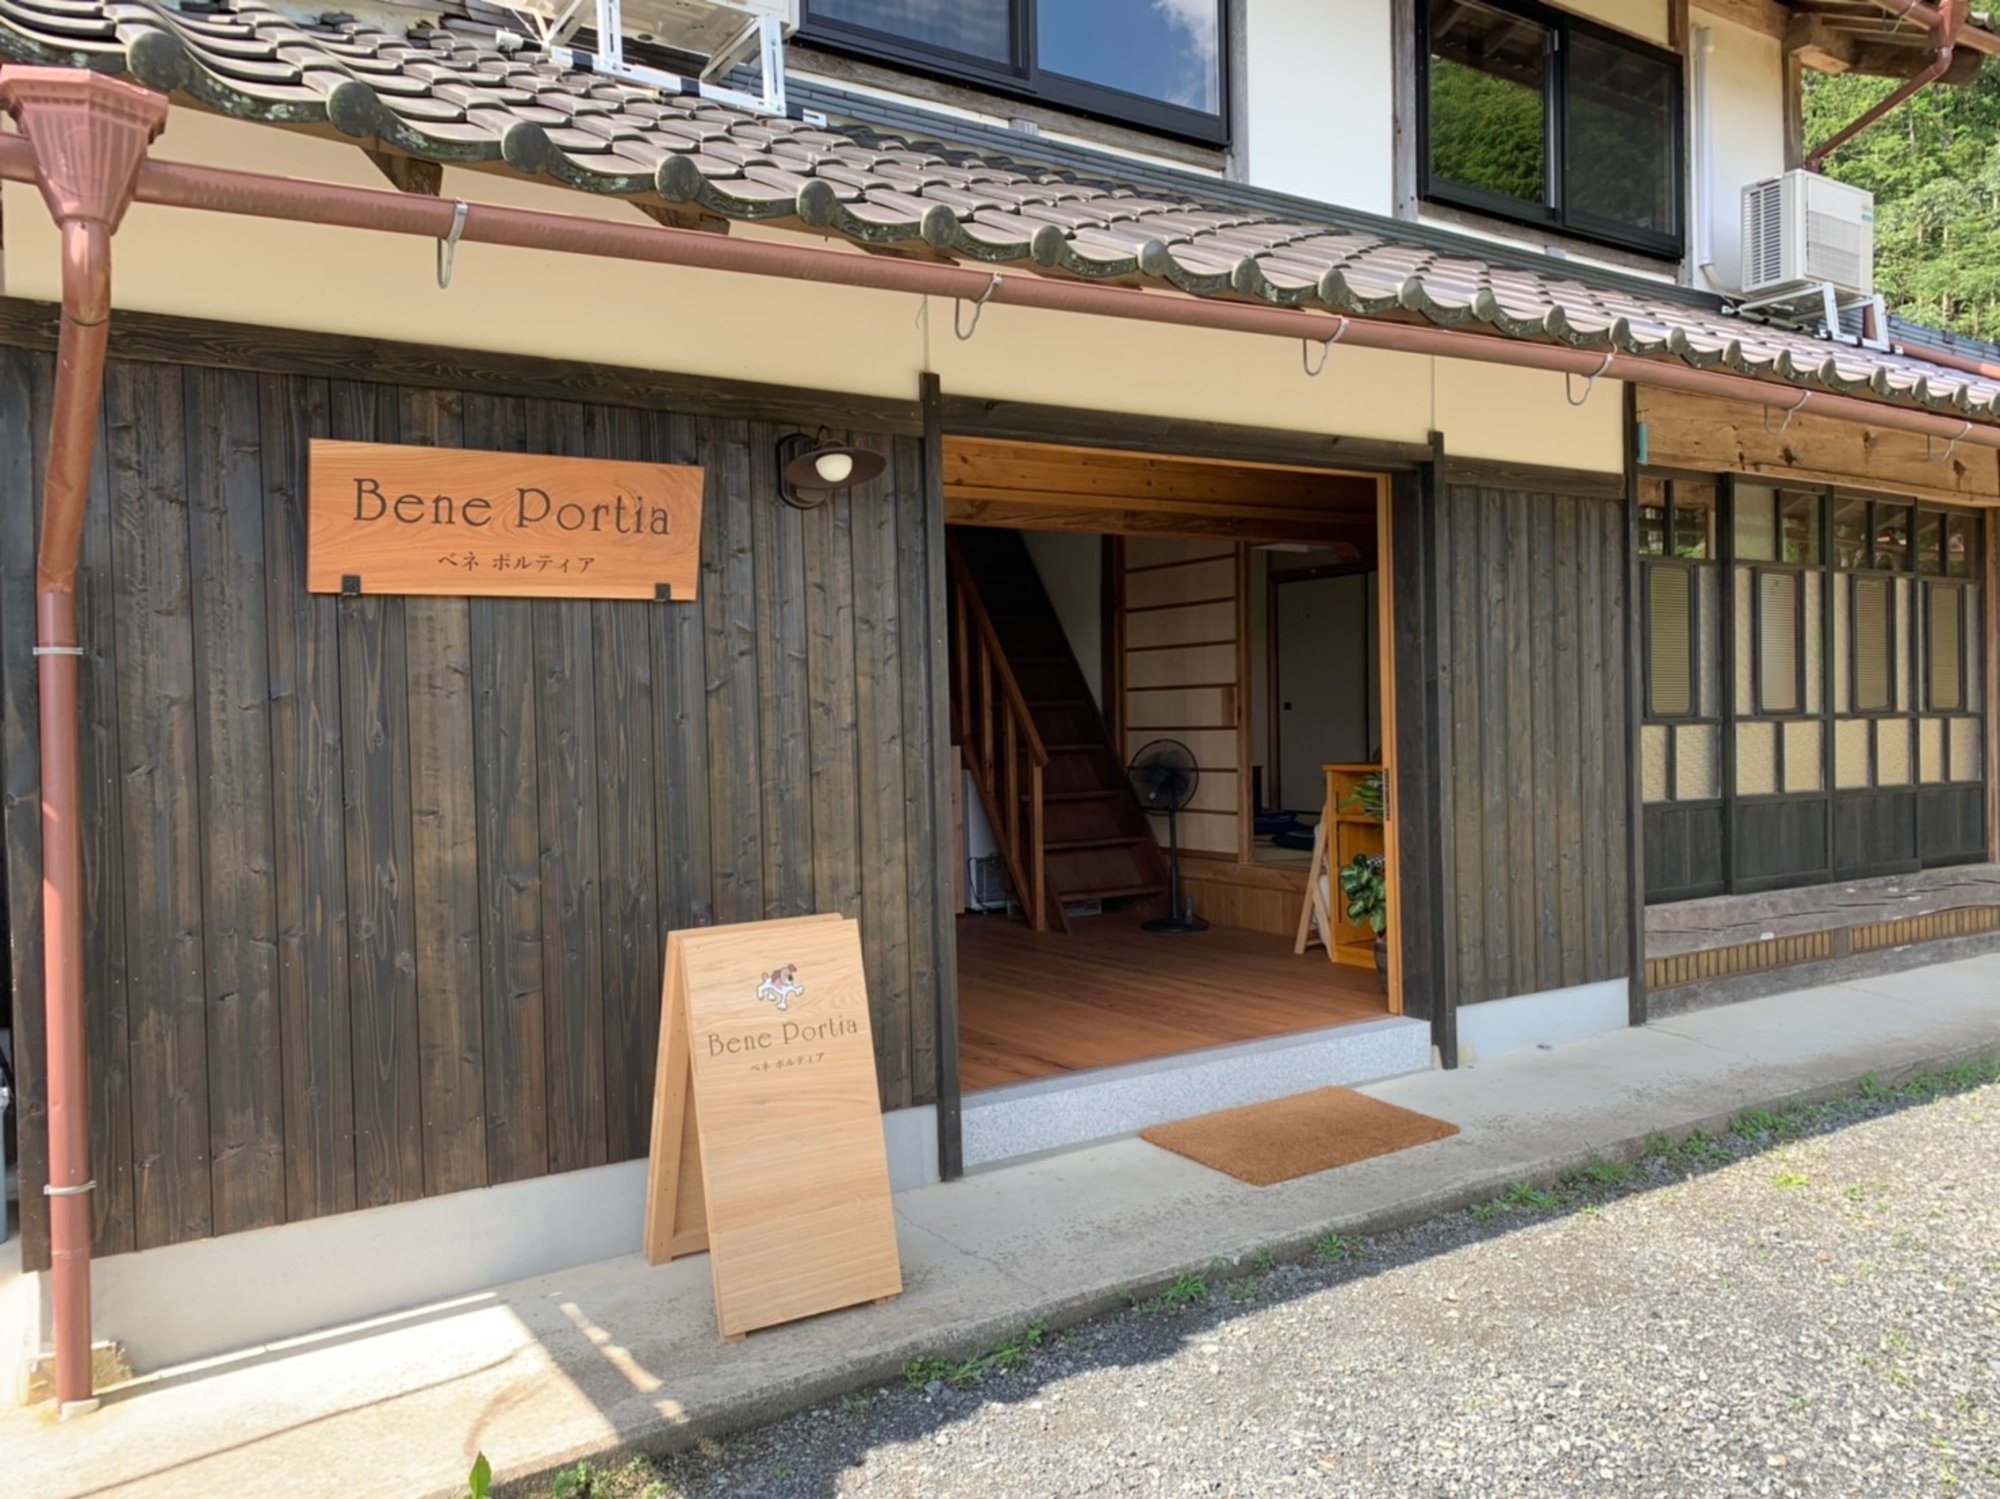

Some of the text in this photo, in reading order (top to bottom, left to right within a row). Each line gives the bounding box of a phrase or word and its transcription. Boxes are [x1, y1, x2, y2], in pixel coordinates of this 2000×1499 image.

[353, 478, 670, 535] Bene Portia
[438, 551, 480, 572] ベネ
[708, 1015, 858, 1057] Bene Portia
